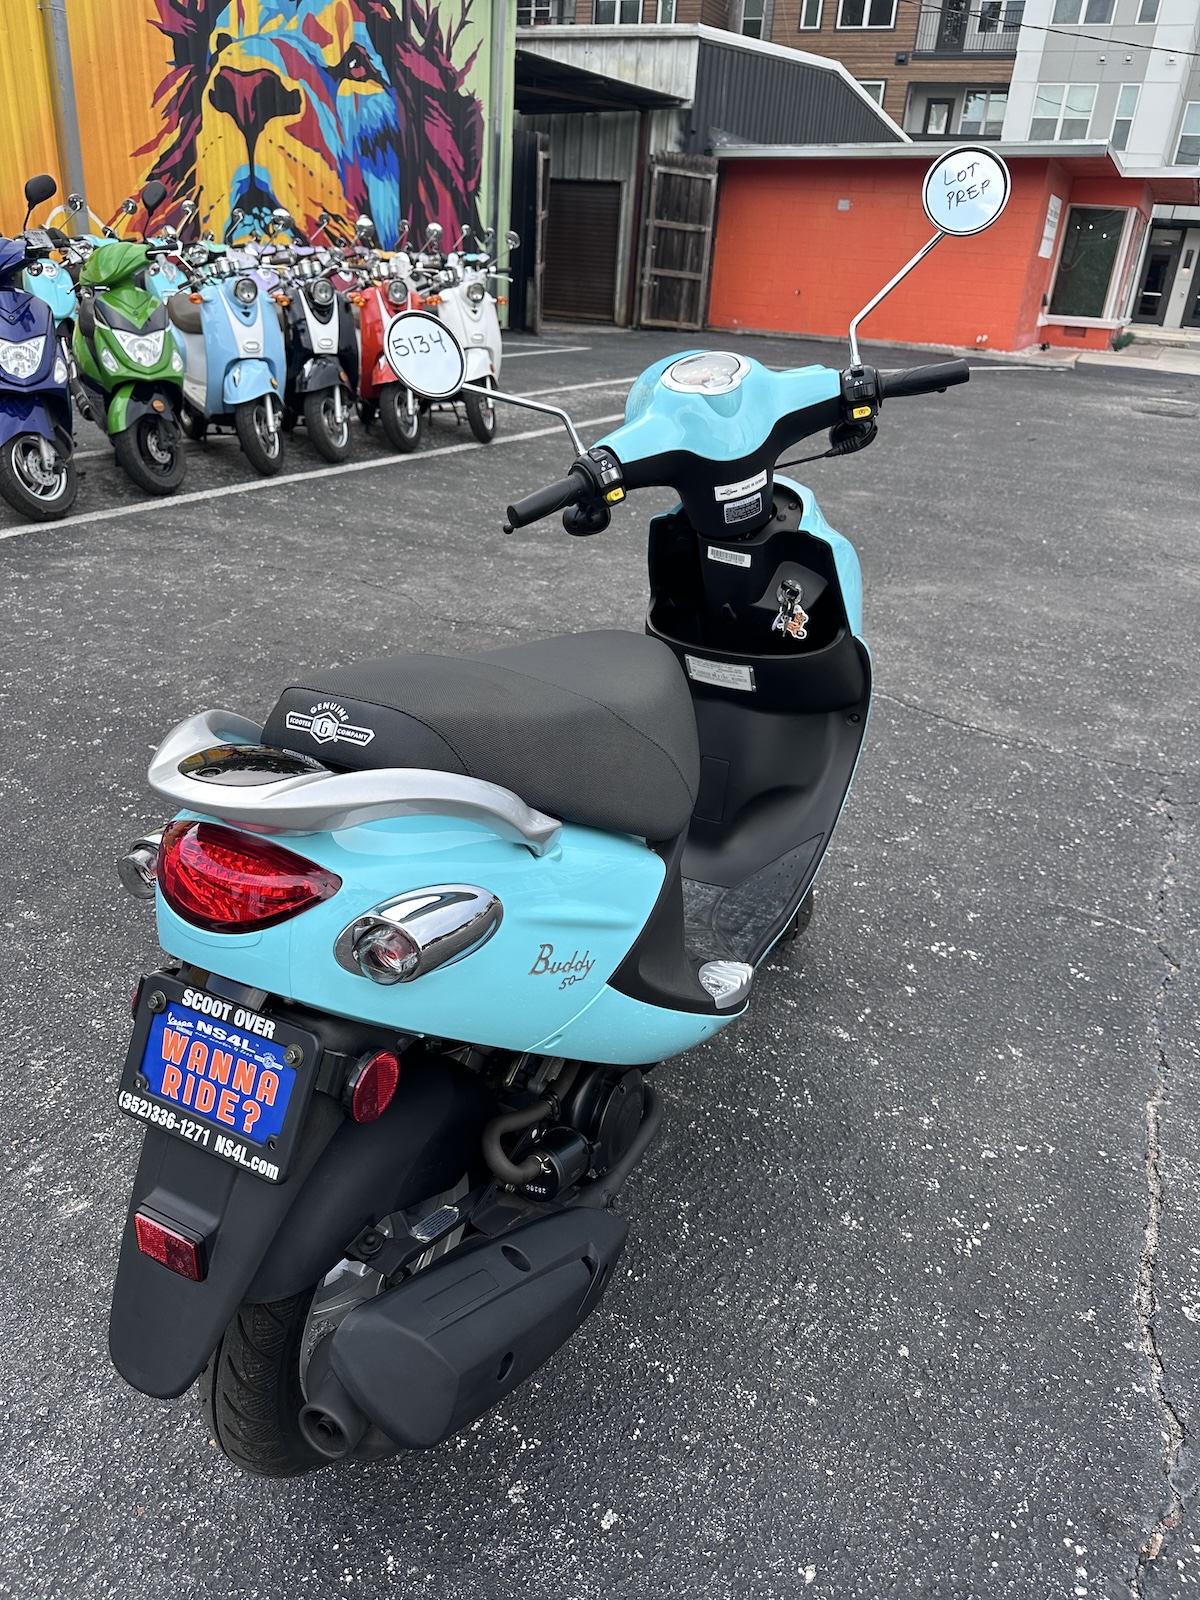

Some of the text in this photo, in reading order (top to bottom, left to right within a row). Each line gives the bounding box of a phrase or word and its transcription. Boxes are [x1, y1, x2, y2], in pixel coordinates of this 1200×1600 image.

[943, 162, 980, 186] LOT
[946, 179, 990, 210] PREP
[392, 330, 447, 357] 5134
[310, 702, 349, 722] GENUINE
[289, 717, 312, 727] SCOOTER
[337, 728, 369, 740] COMPANY
[528, 943, 596, 980] Buddy
[558, 975, 576, 990] 50
[167, 1012, 194, 1028] Vespa
[182, 988, 276, 1040] SCOOT OVER
[196, 1020, 256, 1054] NS4L
[161, 1027, 280, 1106] WANNA
[161, 1065, 261, 1134] RIDE?
[118, 1090, 280, 1181] (352)336-1271 NS4L.com
